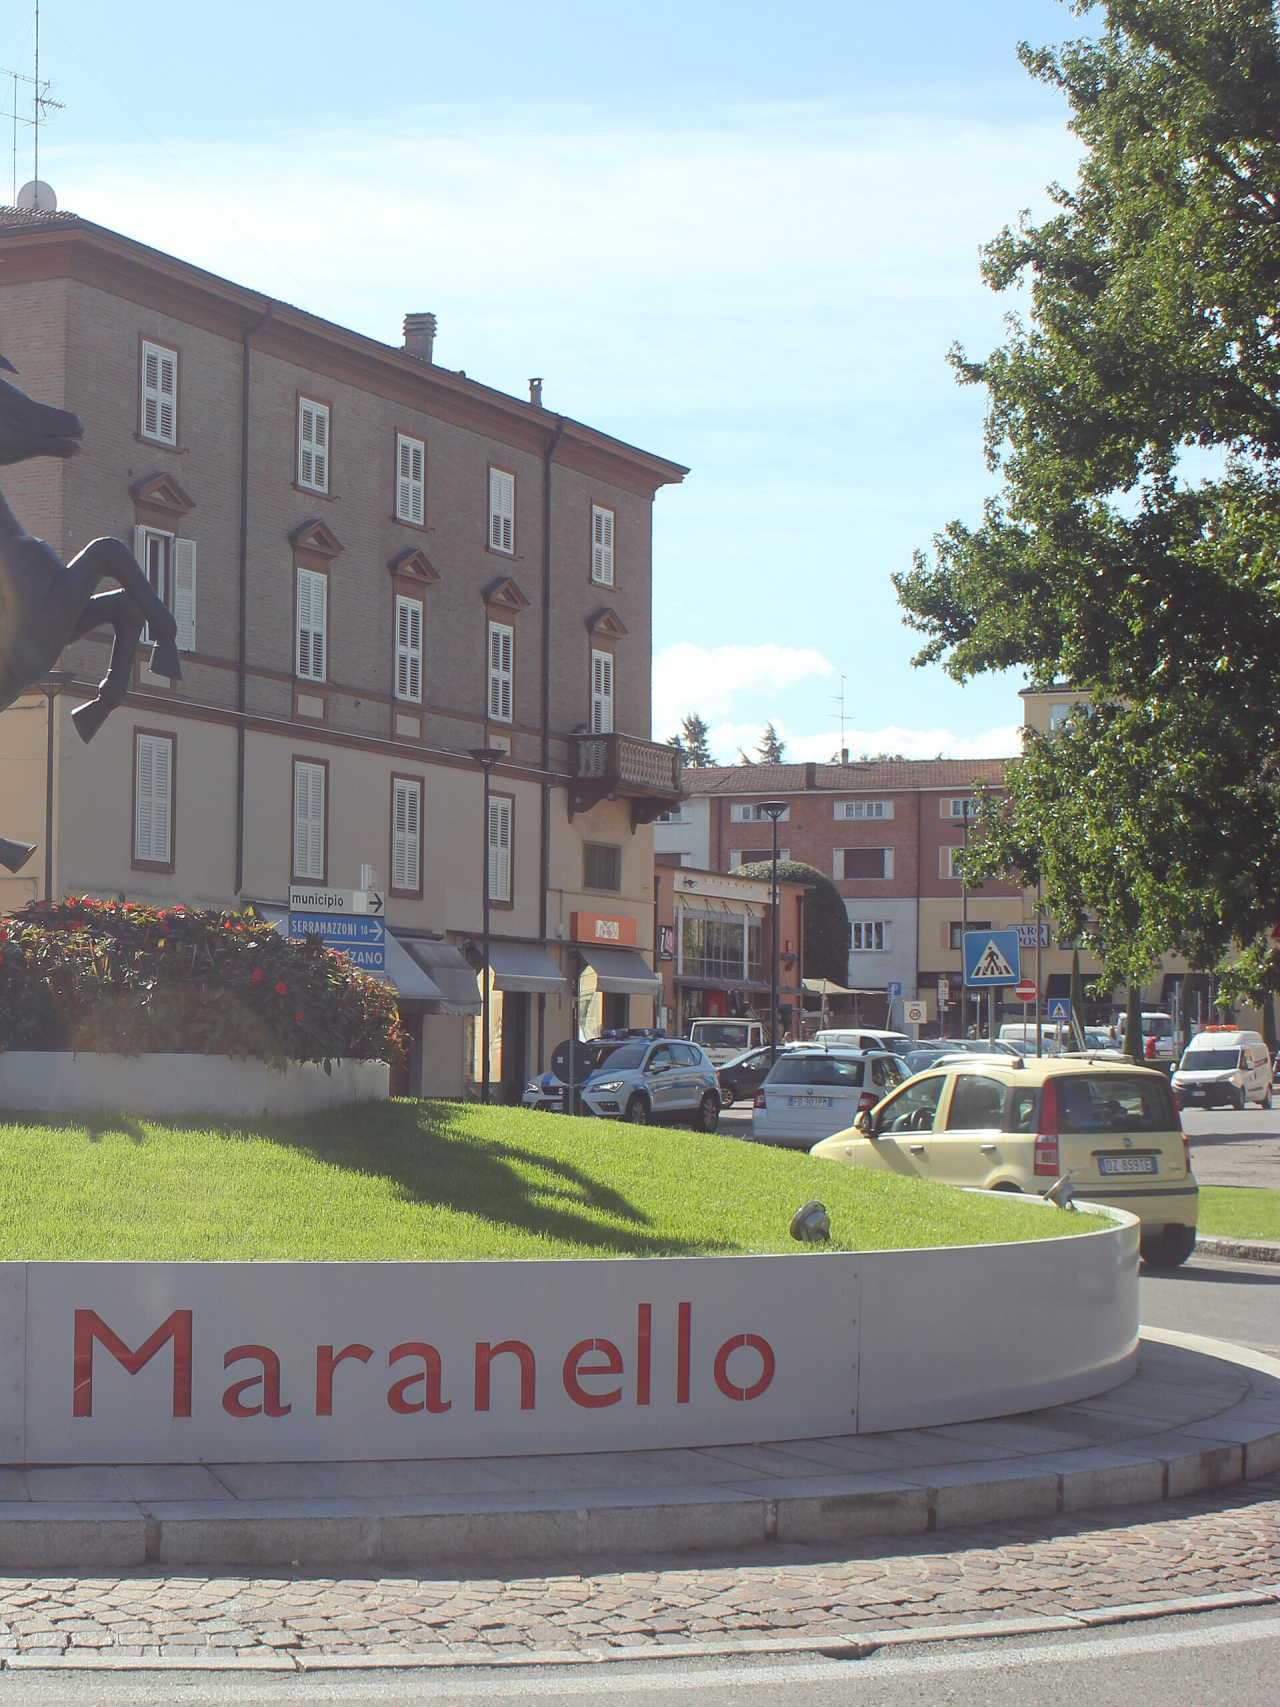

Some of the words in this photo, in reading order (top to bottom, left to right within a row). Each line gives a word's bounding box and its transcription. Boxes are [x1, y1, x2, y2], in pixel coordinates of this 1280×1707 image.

[292, 893, 344, 908] municipio
[292, 920, 357, 936] SERRAMAZZONI
[361, 925, 368, 935] 18
[1012, 926, 1044, 935] ARO
[1106, 1160, 1118, 1171] DZ
[1122, 1159, 1151, 1171] 859TE
[73, 1302, 776, 1418] Maranello
